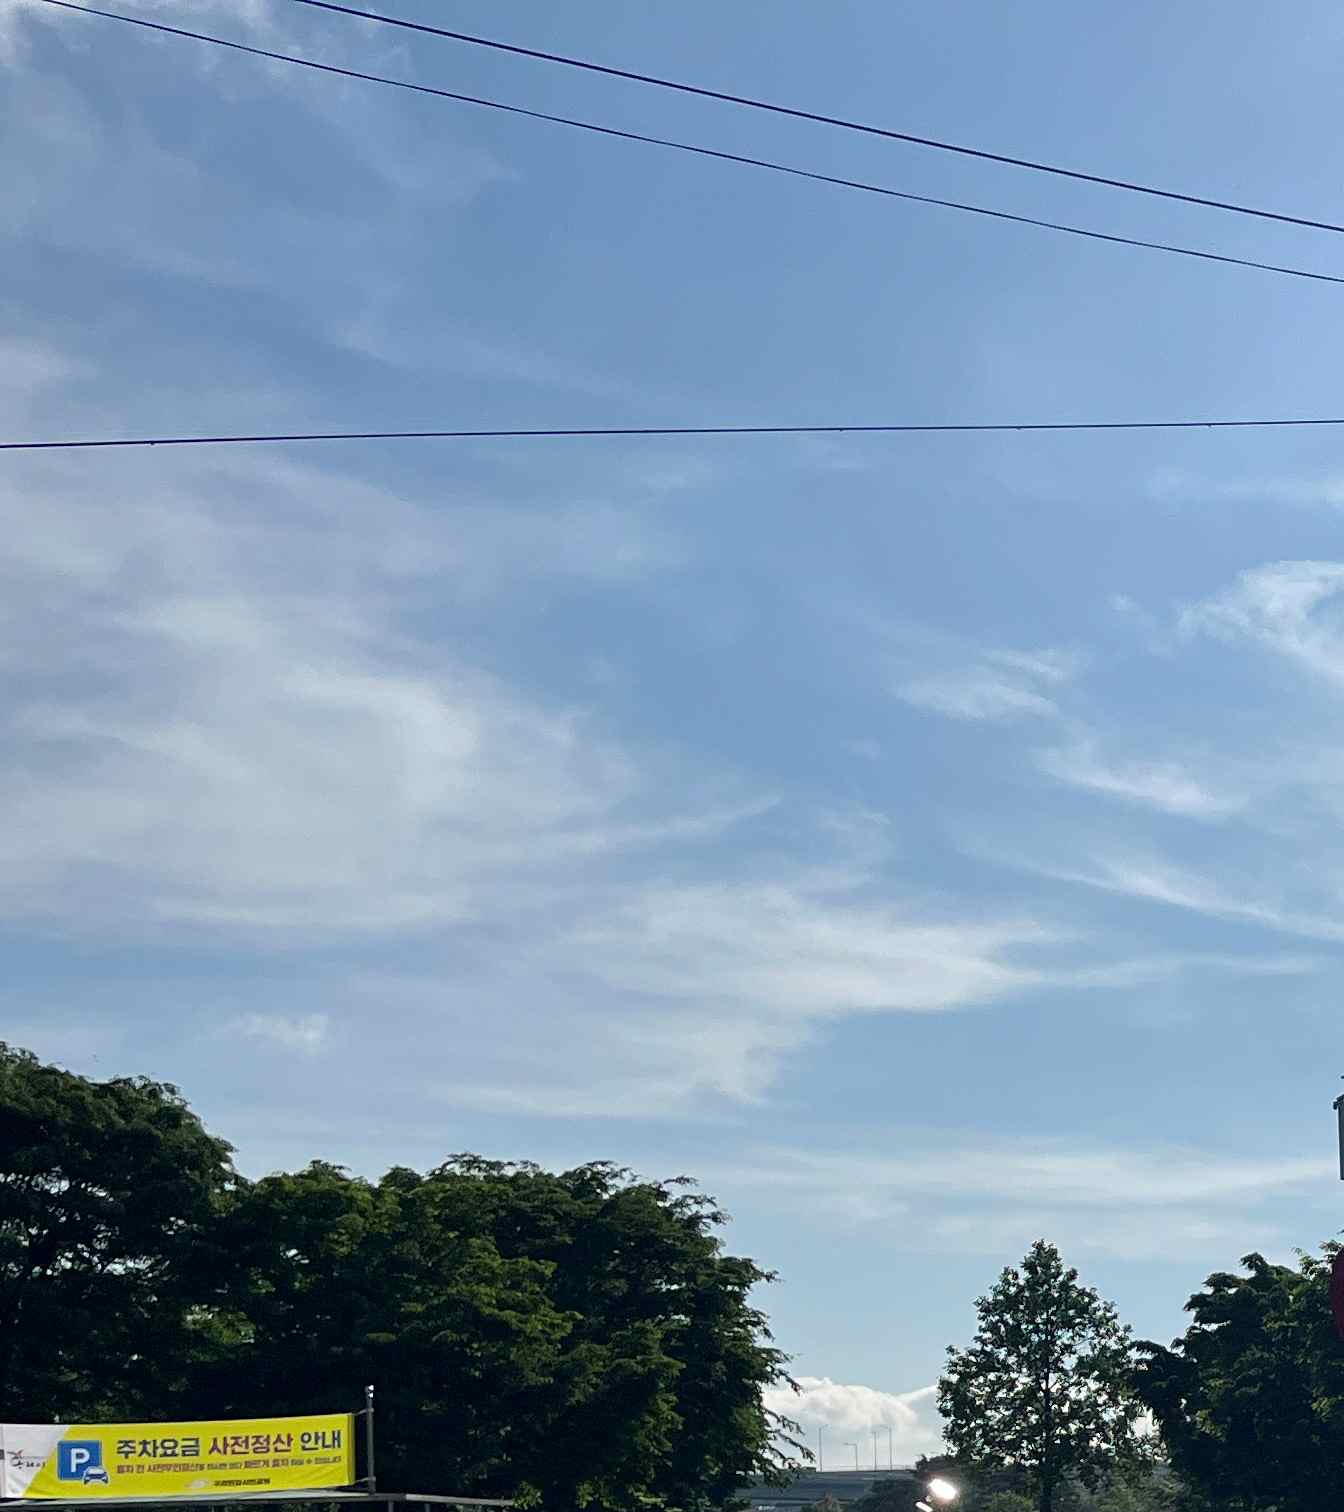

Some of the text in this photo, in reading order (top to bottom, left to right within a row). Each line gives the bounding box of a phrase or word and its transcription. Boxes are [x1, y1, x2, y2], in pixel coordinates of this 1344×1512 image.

[116, 1430, 342, 1460] 주차요금 사전정산 안내
[70, 1447, 89, 1473] P
